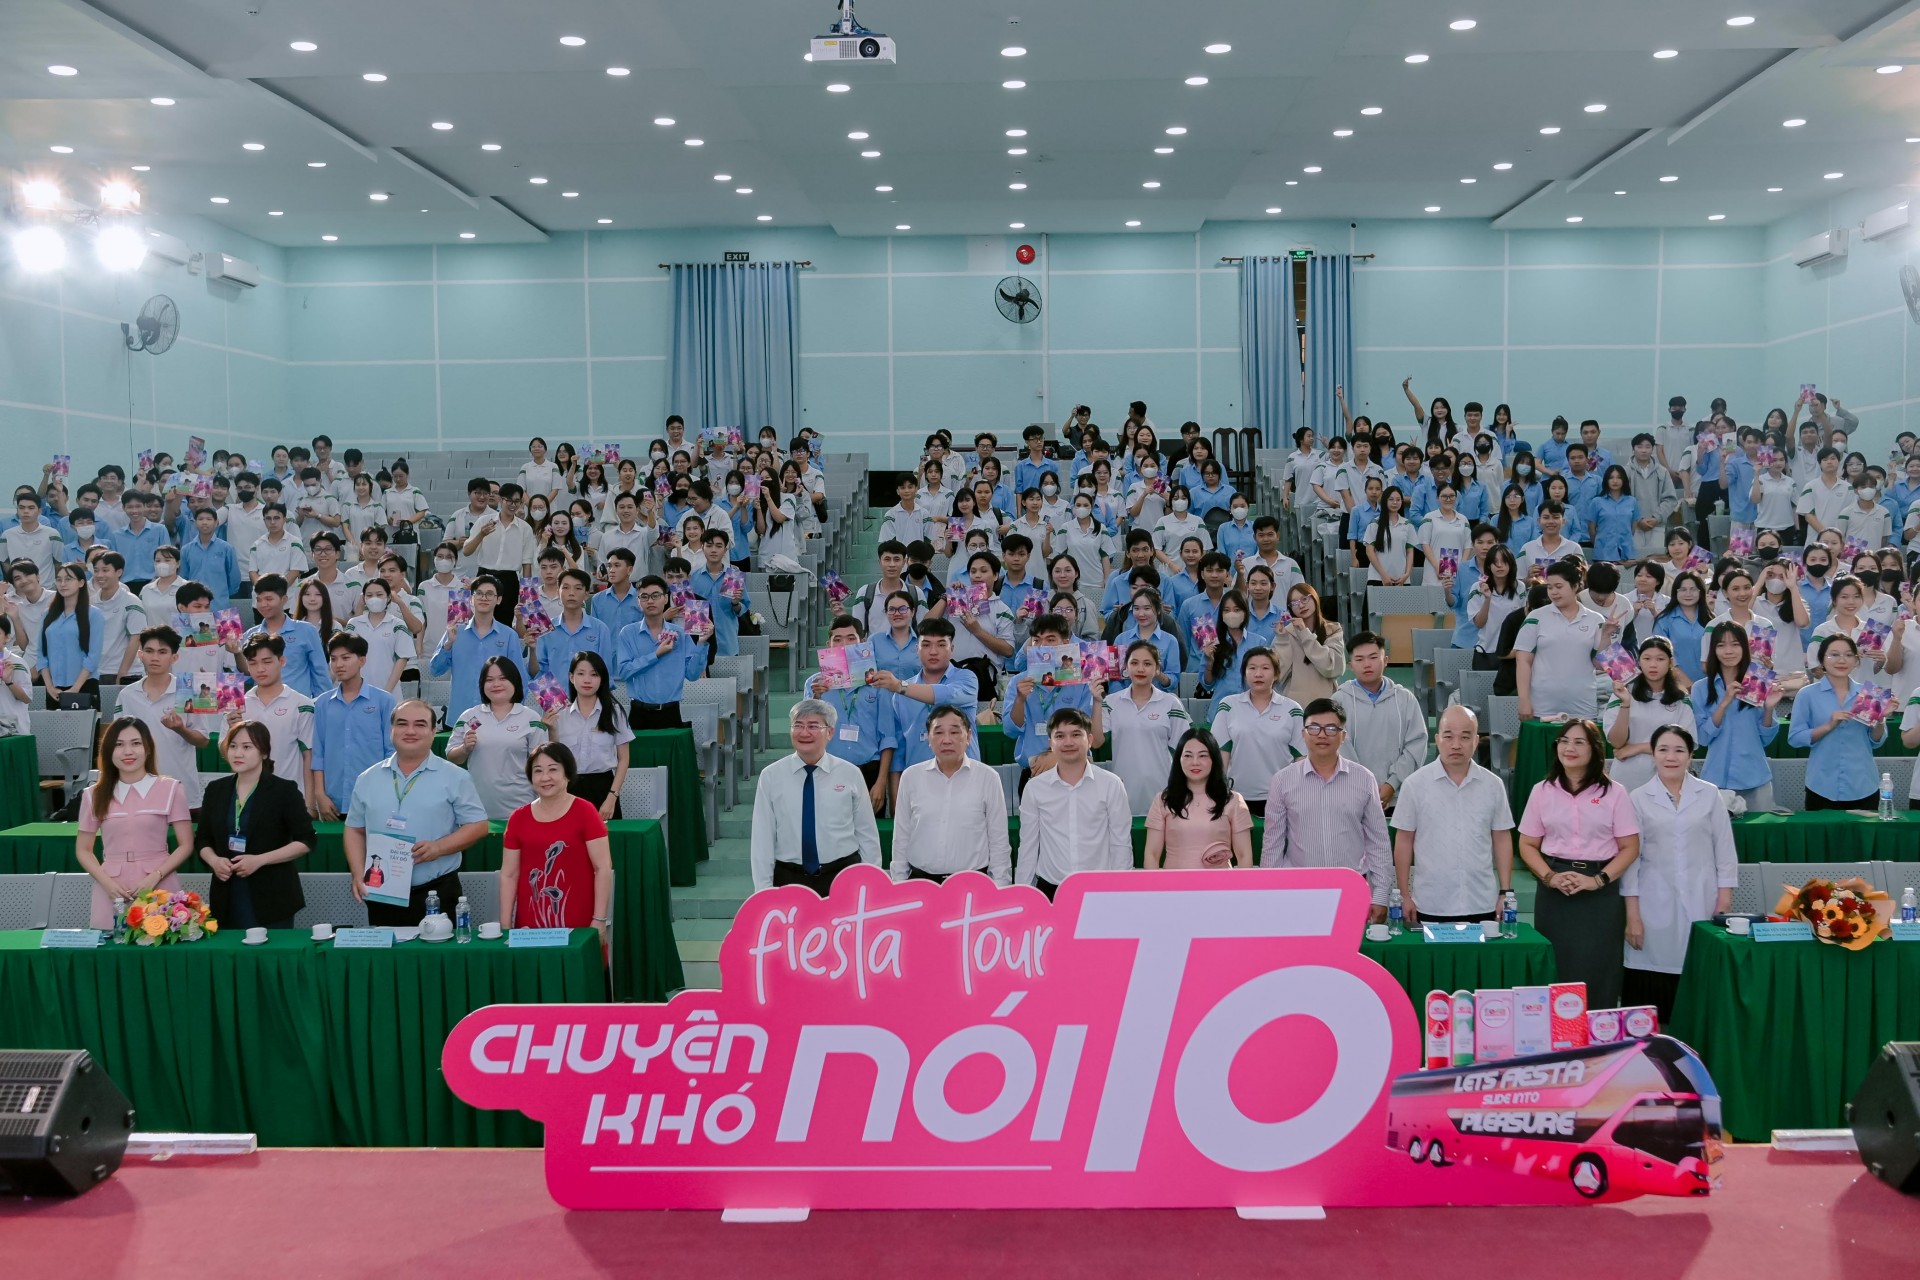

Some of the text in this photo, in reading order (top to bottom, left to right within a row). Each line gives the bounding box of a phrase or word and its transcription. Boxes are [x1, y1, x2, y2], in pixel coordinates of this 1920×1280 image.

[748, 885, 1054, 1005] fiesta tour
[469, 1009, 770, 1087] CHUYỆN
[581, 888, 1394, 1173] KHÓ NÓI TO
[1454, 1060, 1585, 1092] LETS FIESTA
[1482, 1091, 1540, 1105] SLIDE INTO
[1460, 1111, 1577, 1135] PLEASURE
